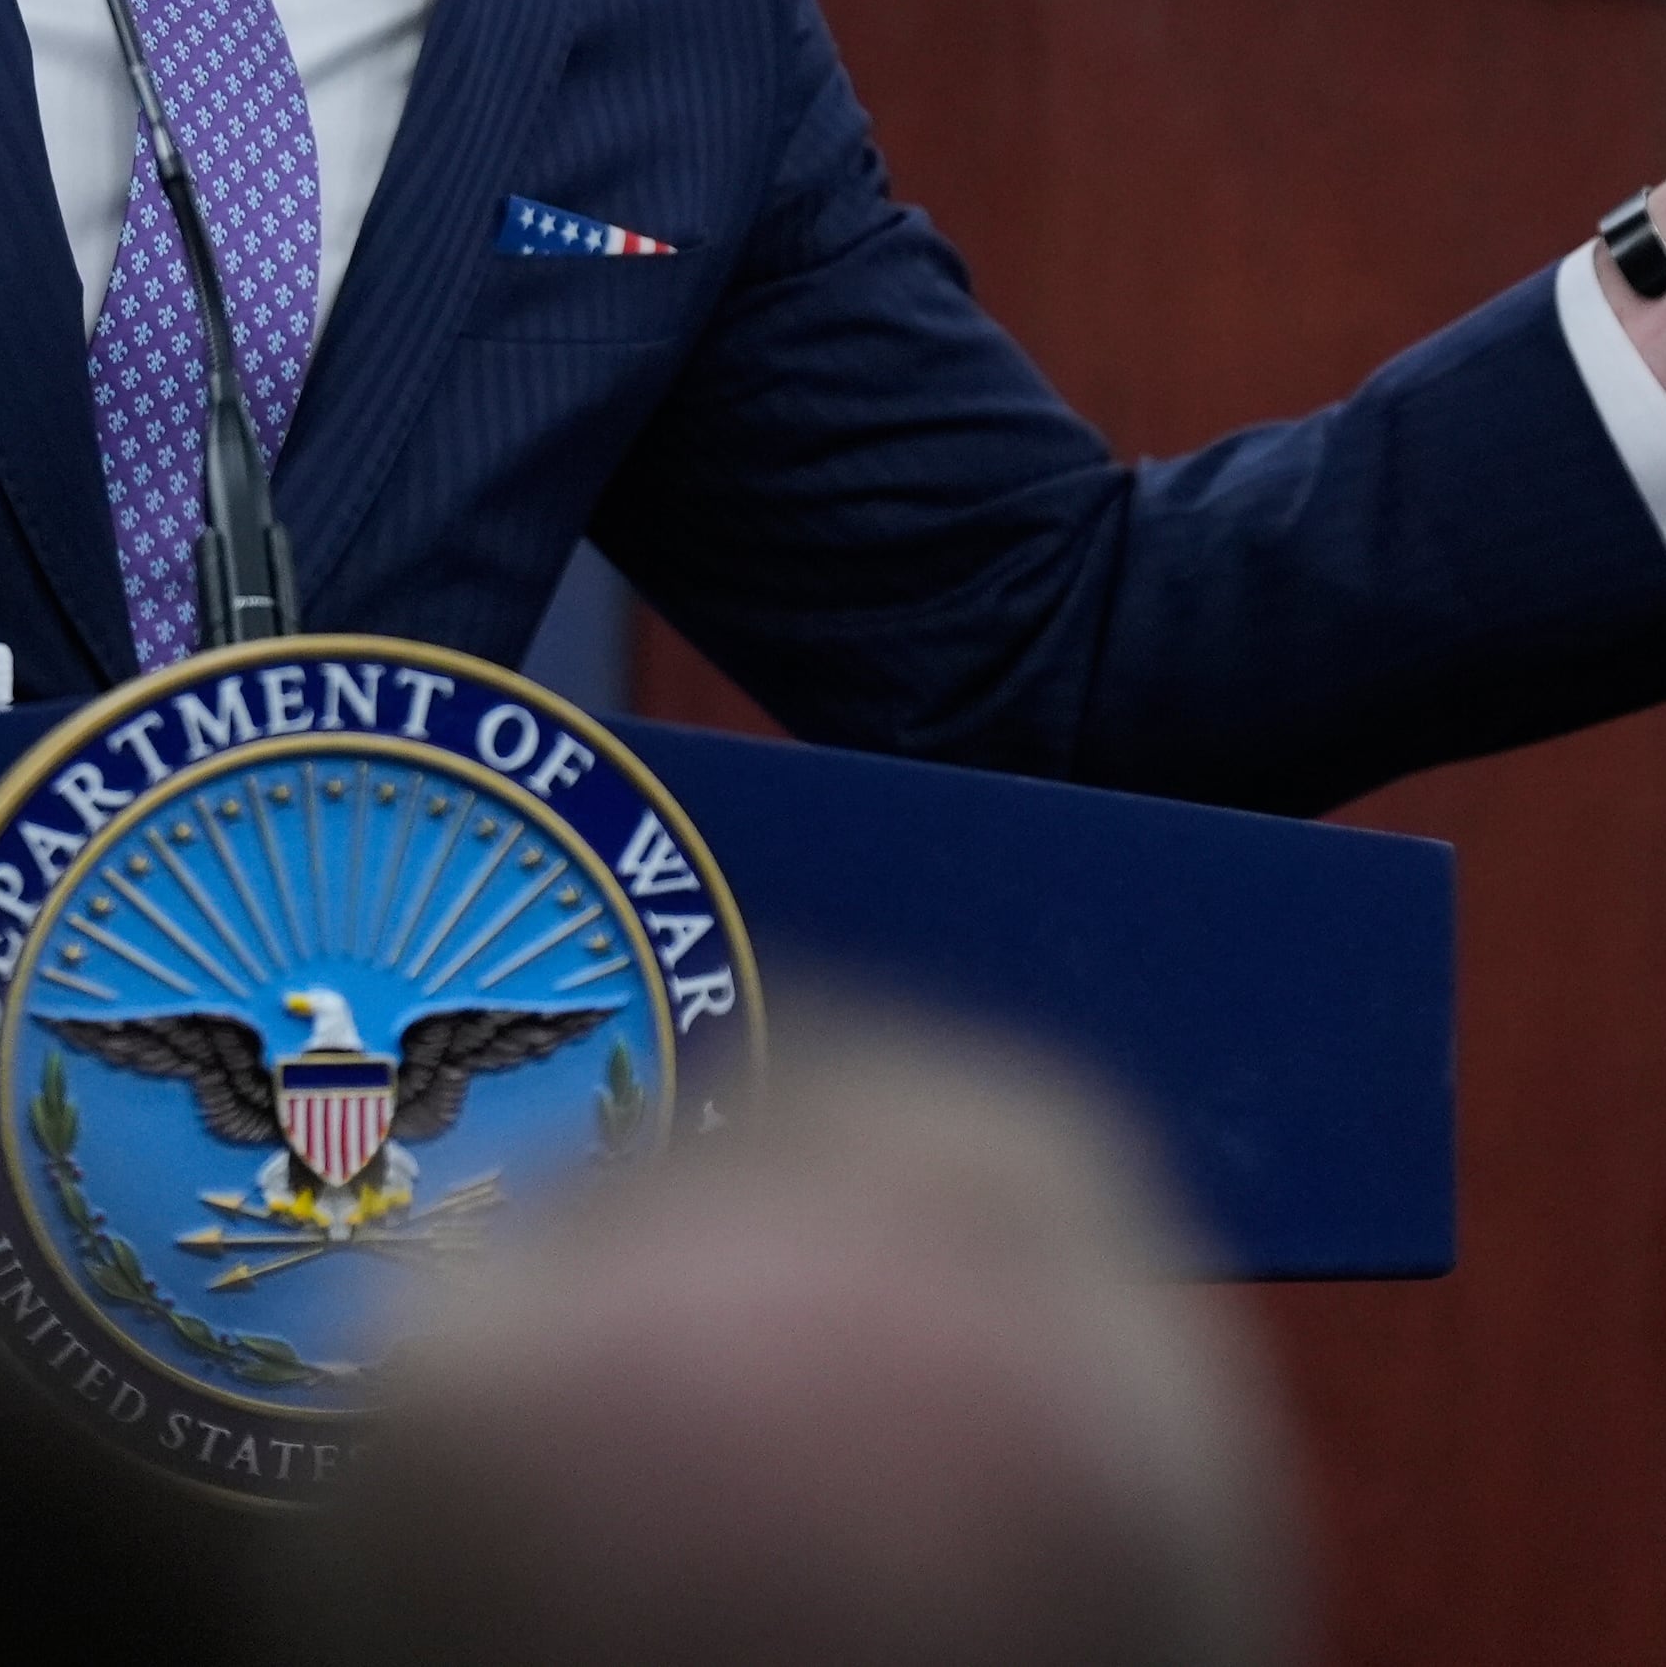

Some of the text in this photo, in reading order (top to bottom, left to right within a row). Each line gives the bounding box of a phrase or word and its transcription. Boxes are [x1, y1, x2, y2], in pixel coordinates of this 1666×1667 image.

[475, 704, 595, 797] OF
[617, 810, 735, 1030] WAR
[159, 1412, 367, 1481] STATE
